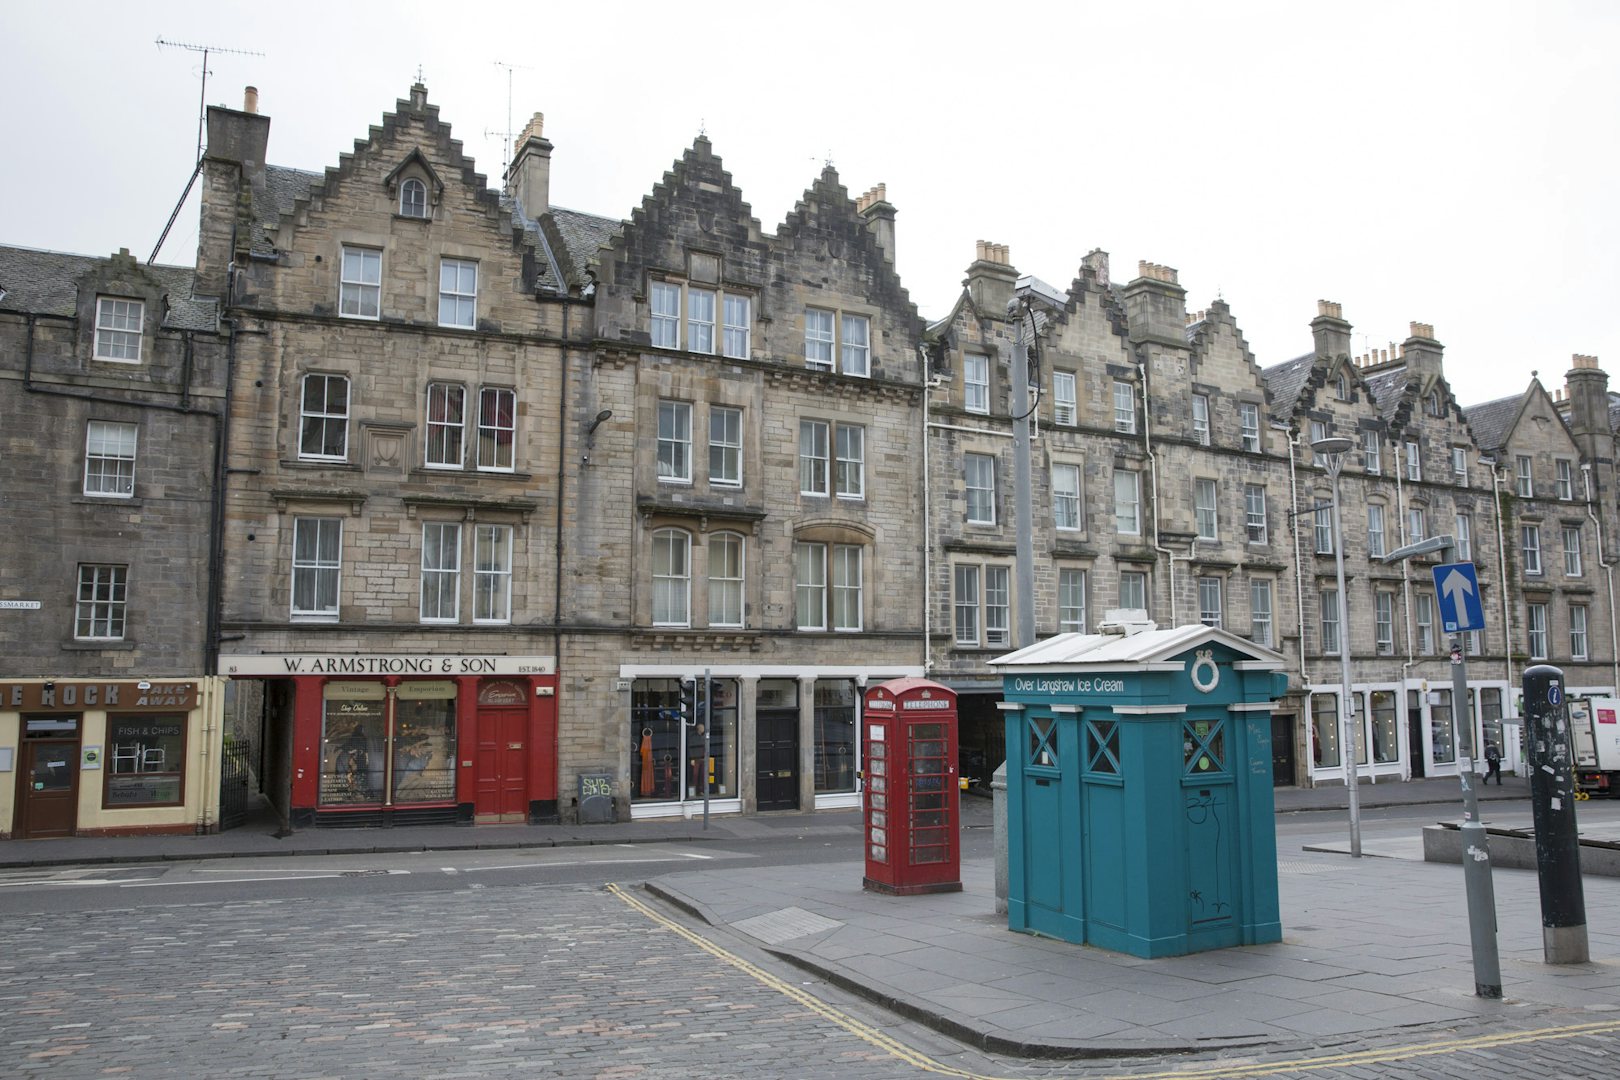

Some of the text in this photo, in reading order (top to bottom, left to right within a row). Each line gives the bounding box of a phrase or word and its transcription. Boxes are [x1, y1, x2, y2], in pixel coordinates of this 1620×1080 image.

[284, 658, 496, 673] W. ARMSTRONG & SON
[1015, 678, 1124, 694] Over Langshaw Ice Cream
[0, 685, 119, 707] E ROCK
[136, 696, 189, 705] AWAY
[905, 701, 947, 709] TELEPHONE
[118, 726, 180, 736] FISH & CHIPS
